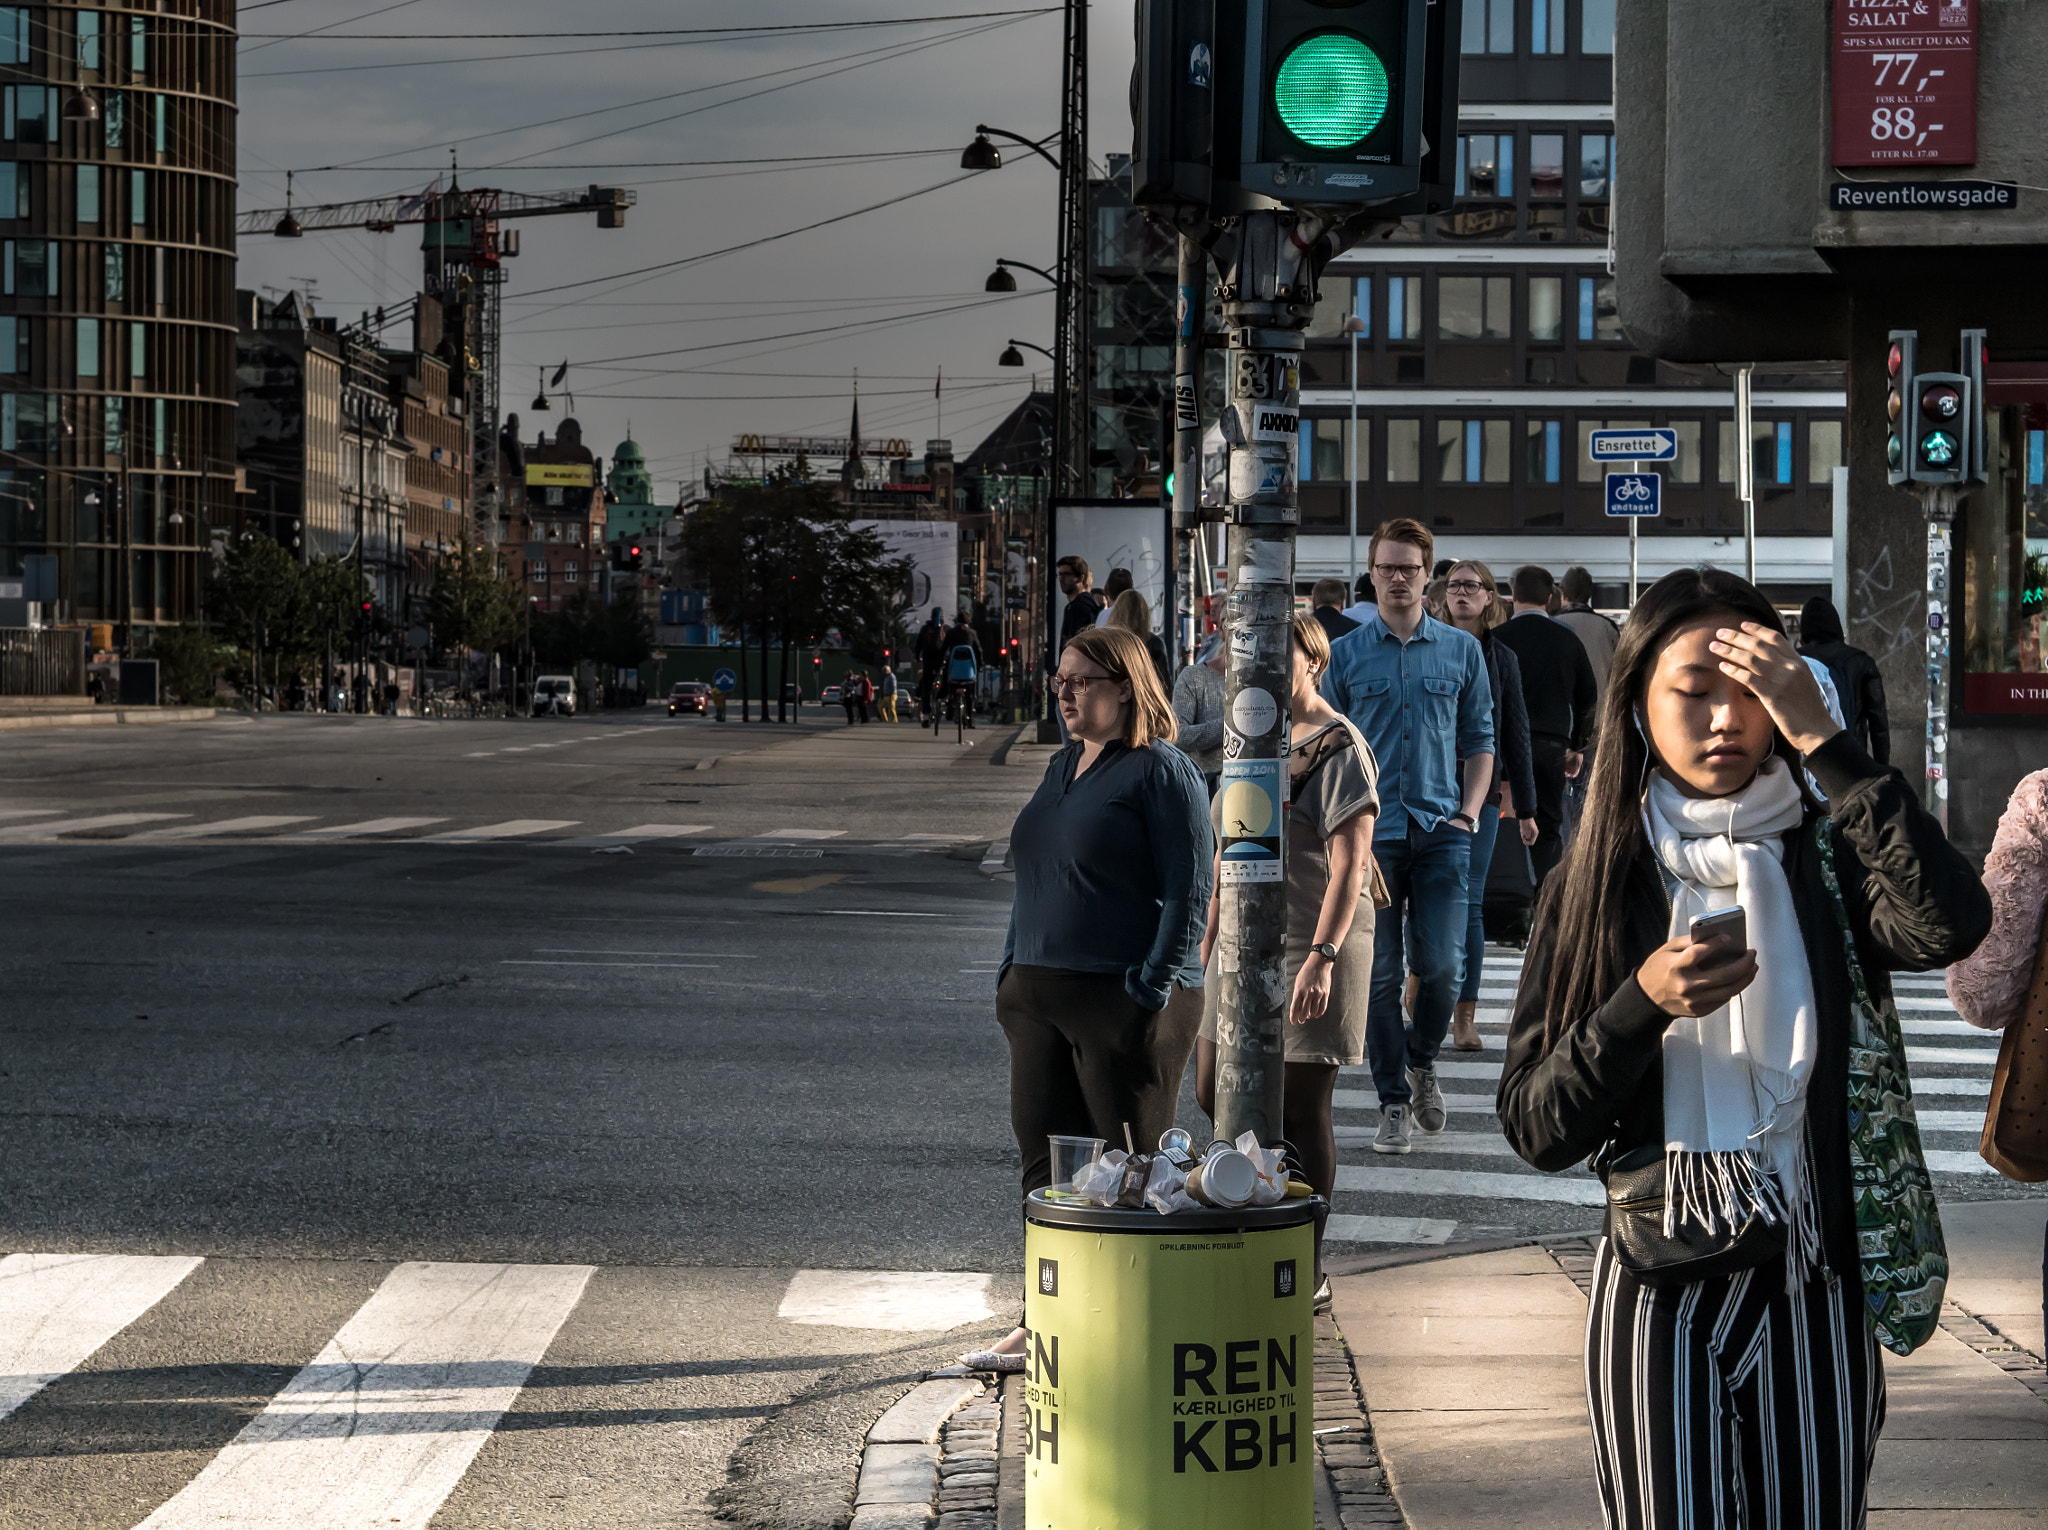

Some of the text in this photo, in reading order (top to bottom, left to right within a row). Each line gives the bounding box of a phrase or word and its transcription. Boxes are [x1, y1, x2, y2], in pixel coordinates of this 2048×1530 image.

[1913, 0, 1929, 15] &
[1848, 12, 1910, 26] SALAT
[1843, 35, 1970, 47] SPIS SÅ MEGET DU KAN
[1872, 53, 1945, 92] 77,-
[1914, 94, 1936, 103] 17.00
[1870, 106, 1944, 147] 88,-
[1871, 150, 1900, 159] EFTER
[1917, 149, 1938, 158] 17.00
[1837, 186, 2009, 206] Reventlowsgade
[1176, 385, 1197, 422] ALIS
[1597, 439, 1656, 452] Ensrettet
[1611, 503, 1654, 513] undtaget
[2011, 688, 2025, 699] IN
[1159, 1241, 1246, 1251] OPKLÆBNING FORBUDT
[1025, 1328, 1059, 1389] EN
[1173, 1334, 1297, 1397] REN
[1042, 1391, 1059, 1408] TIL
[1173, 1393, 1297, 1416] KÆRLIGHED TIL
[1025, 1403, 1059, 1465] BH
[1173, 1412, 1297, 1474] KBH
